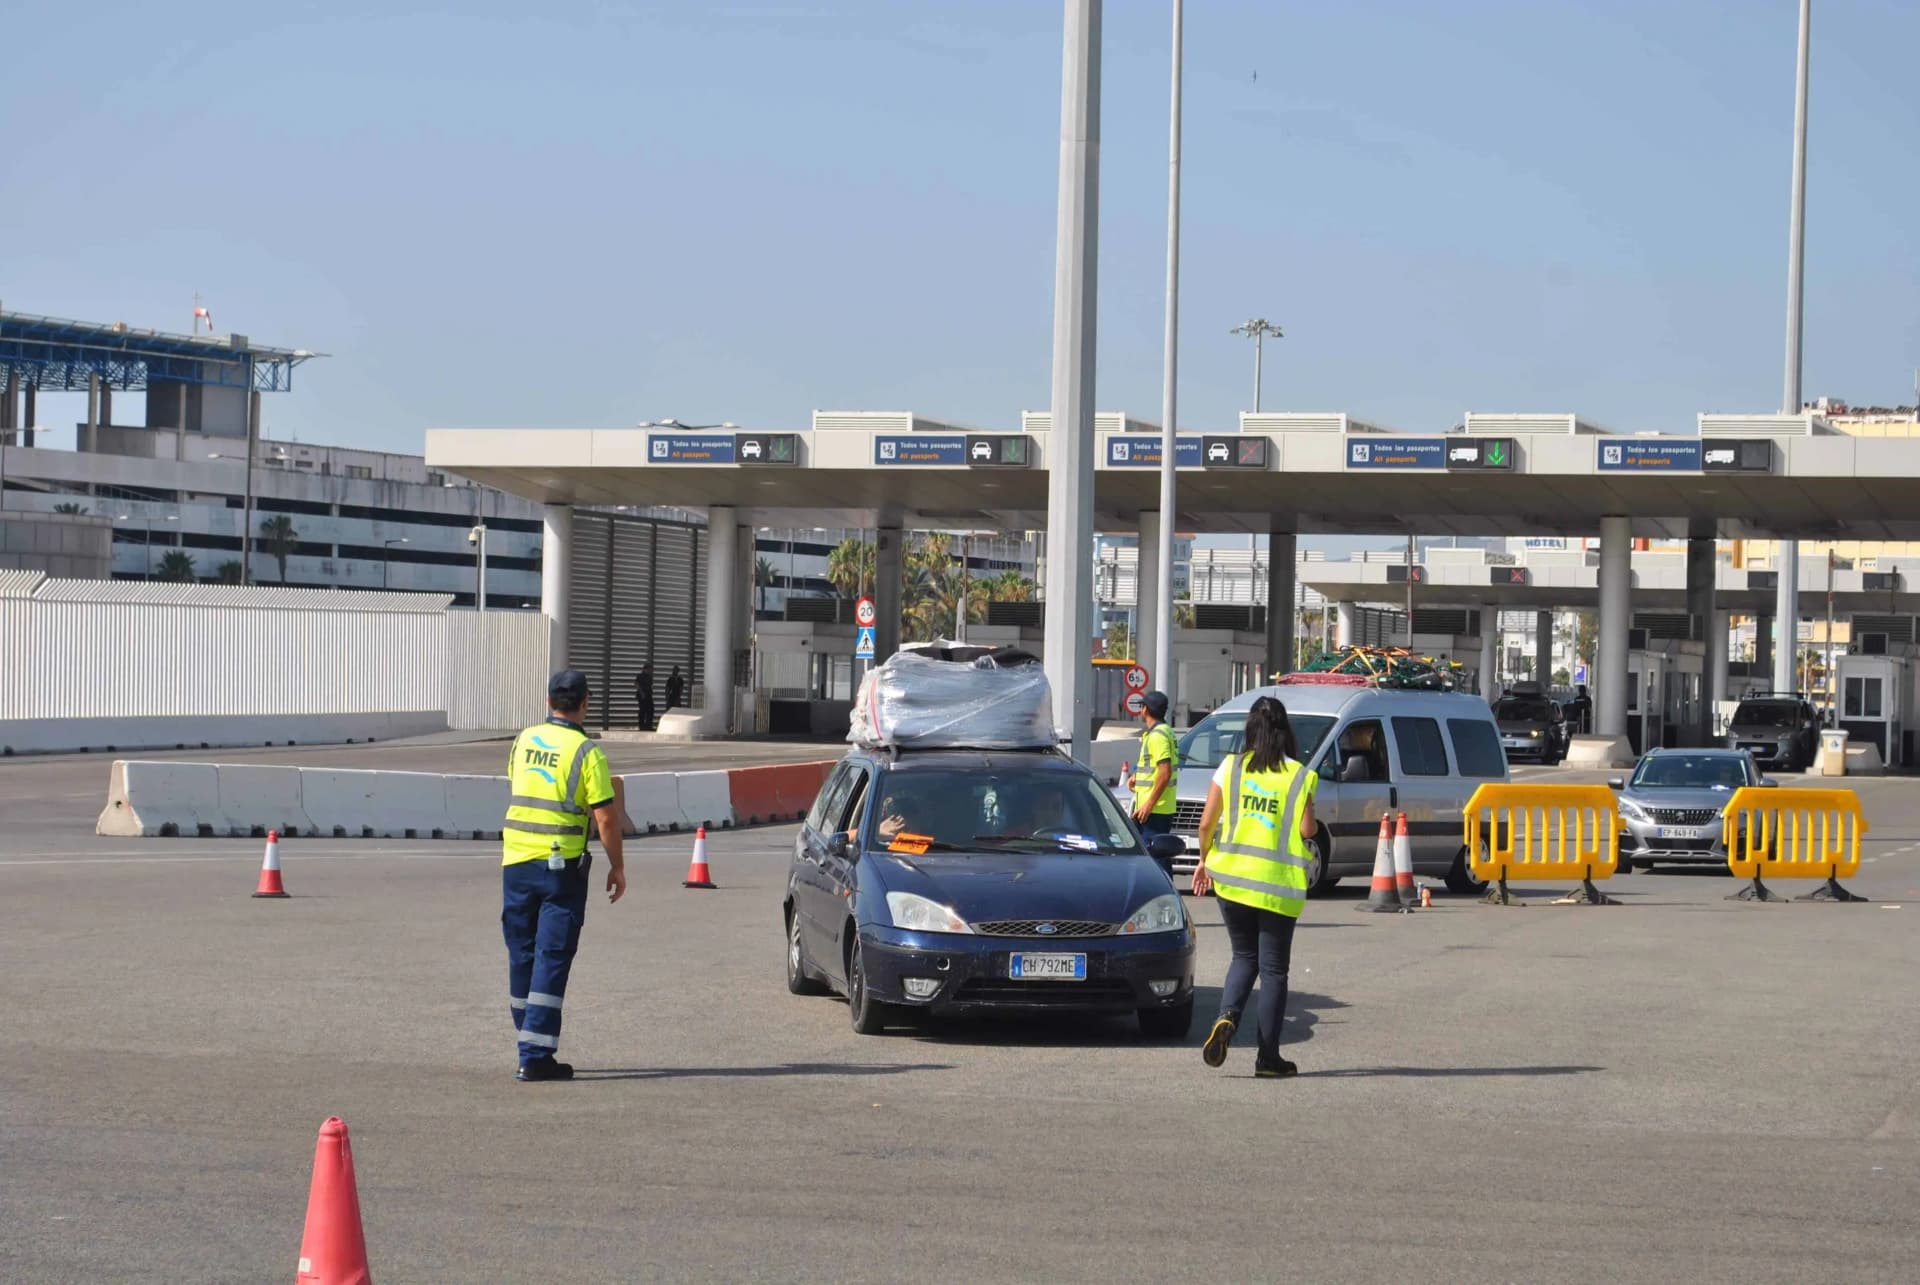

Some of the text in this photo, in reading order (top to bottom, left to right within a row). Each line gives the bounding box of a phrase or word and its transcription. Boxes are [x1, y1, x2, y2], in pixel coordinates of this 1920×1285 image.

[1374, 444, 1392, 452] Todos
[1394, 444, 1404, 452] los
[1525, 538, 1562, 548] HOTEL
[860, 607, 873, 617] 20
[525, 749, 560, 768] TME
[1242, 795, 1279, 815] TME
[1022, 959, 1037, 973] CH
[1040, 959, 1074, 973] 792ME
